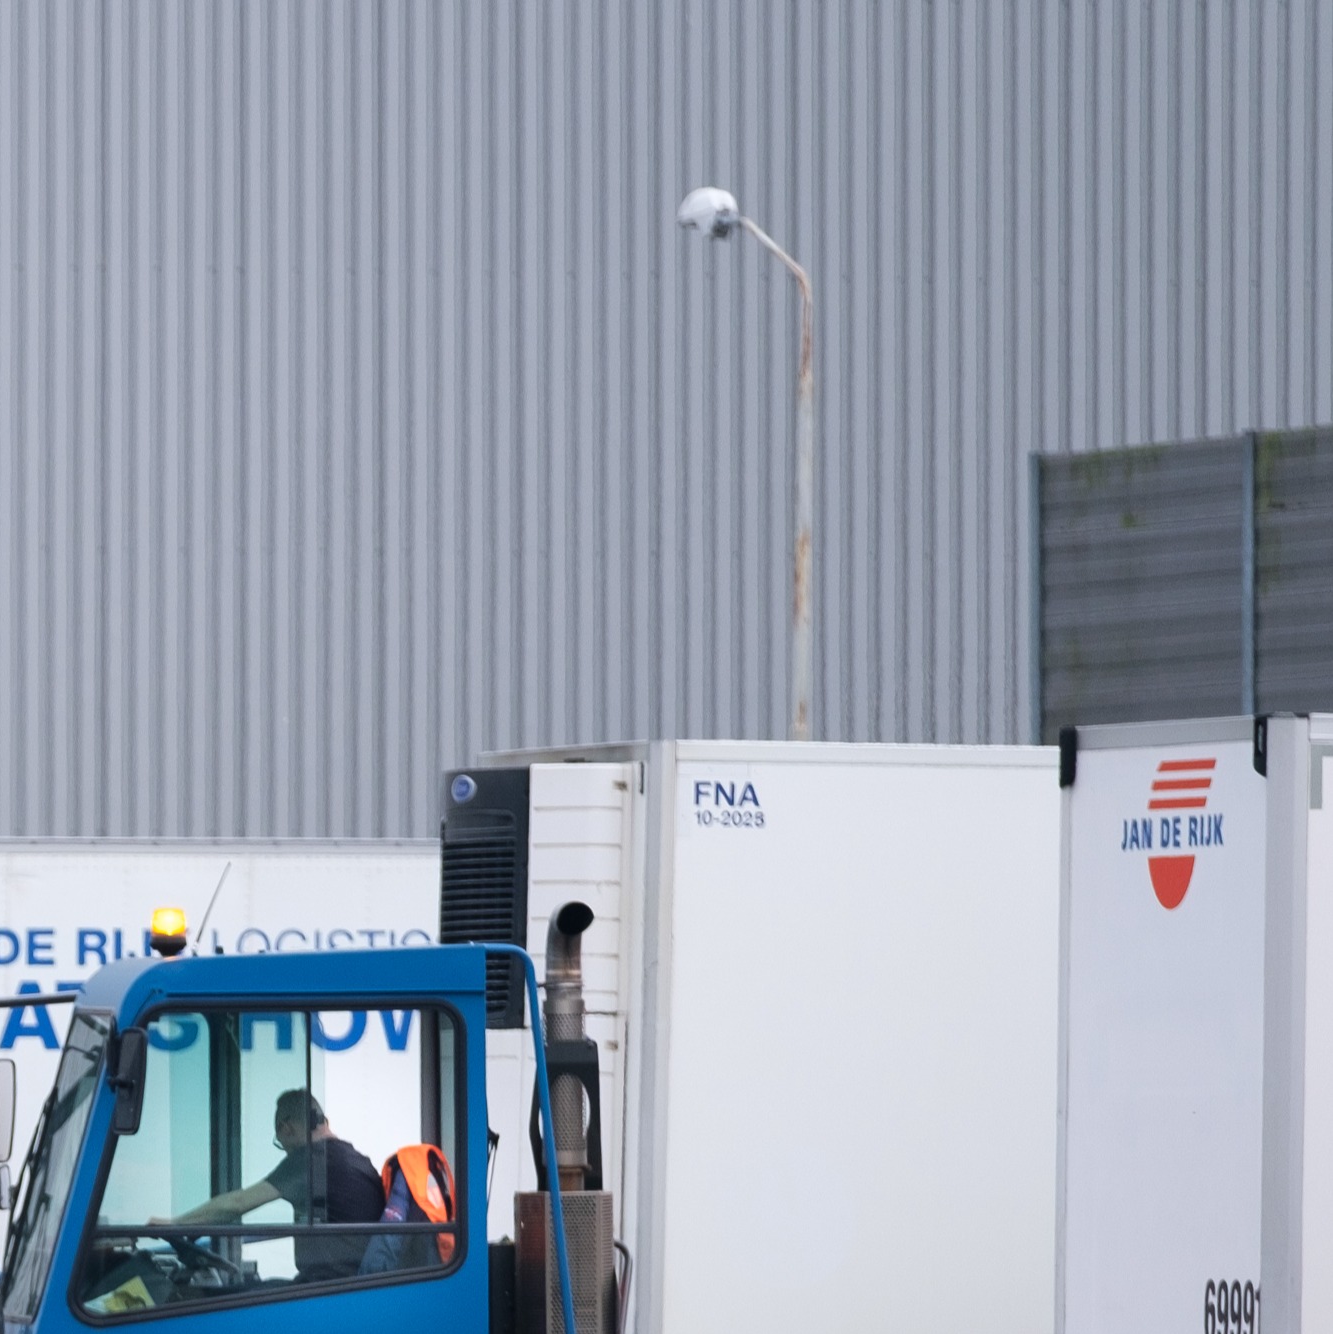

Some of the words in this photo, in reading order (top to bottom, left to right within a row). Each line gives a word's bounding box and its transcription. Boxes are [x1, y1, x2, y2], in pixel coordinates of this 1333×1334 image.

[694, 780, 760, 807] FNA
[1121, 817, 1152, 851] JAN
[1160, 815, 1181, 848] DE
[1188, 813, 1223, 847] RIJK
[77, 928, 152, 965] RIJ
[240, 1011, 413, 1052] HO
